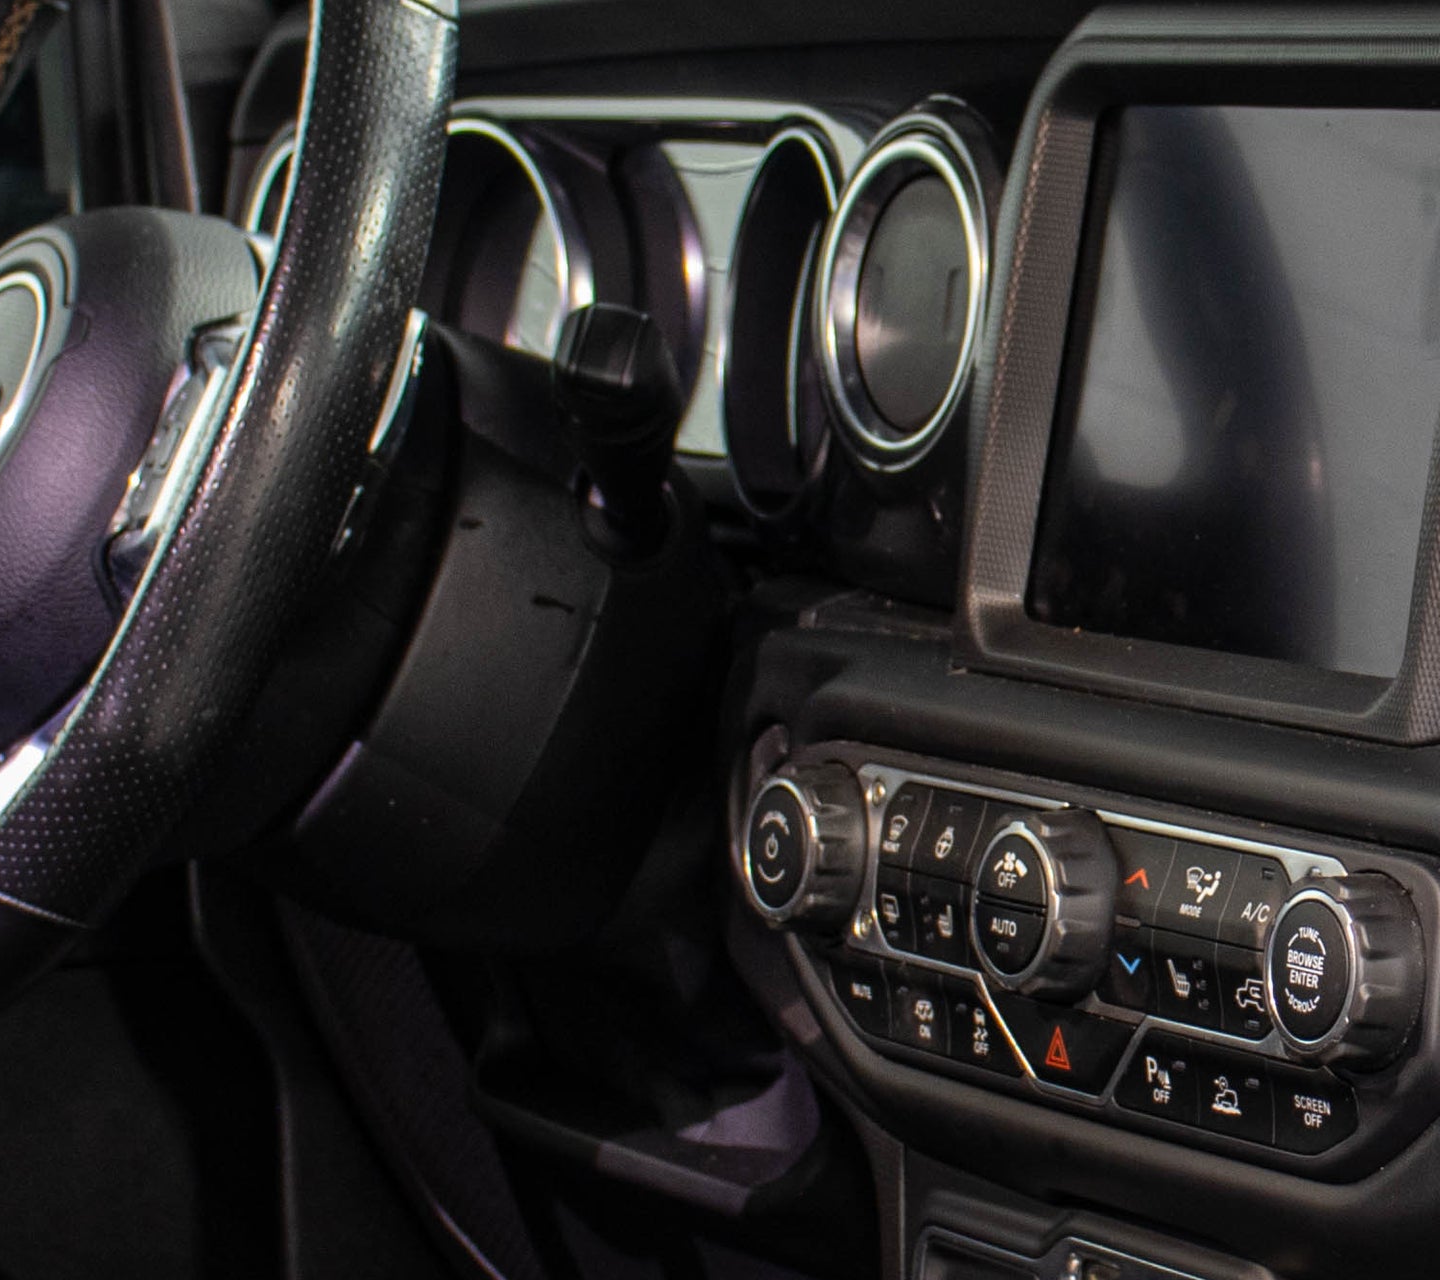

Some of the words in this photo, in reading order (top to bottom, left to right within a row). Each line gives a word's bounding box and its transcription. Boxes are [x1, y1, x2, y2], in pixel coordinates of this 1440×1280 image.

[997, 871, 1017, 889] OFF
[1179, 902, 1203, 919] MODE
[1240, 901, 1271, 923] A/C
[990, 917, 1017, 937] AUTO
[1298, 926, 1320, 942] TUNE
[1286, 949, 1325, 971] BROWSE
[1289, 969, 1320, 990] ENTER
[1288, 993, 1317, 1013] SCROLL
[1153, 1087, 1172, 1105] OFF
[1294, 1094, 1332, 1116] SCREEN
[1303, 1111, 1324, 1129] OFF
